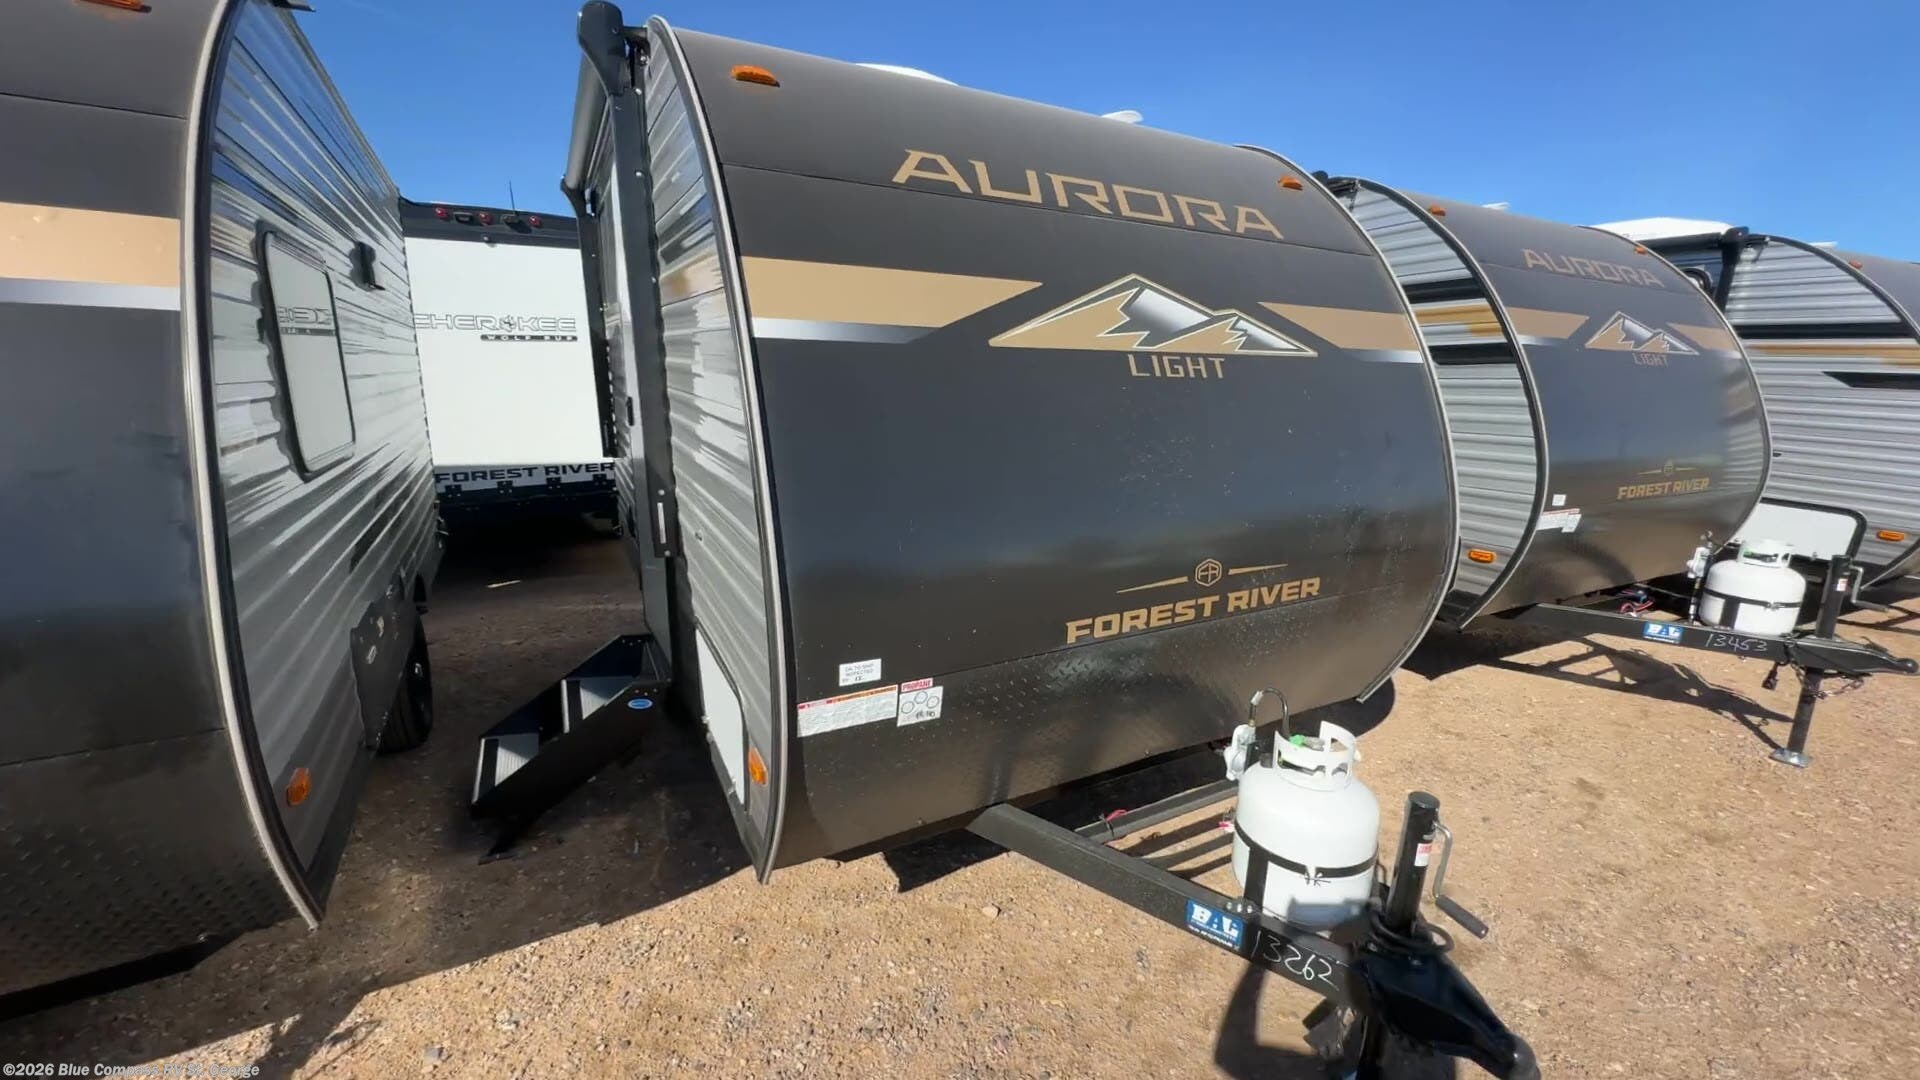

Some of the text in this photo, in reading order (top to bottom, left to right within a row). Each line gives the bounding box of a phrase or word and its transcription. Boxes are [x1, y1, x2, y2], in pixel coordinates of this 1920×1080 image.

[892, 149, 1284, 240] AURORA
[1522, 249, 1665, 288] AURORA
[1127, 354, 1225, 379] LIGHT
[1632, 353, 1669, 366] LIGHT
[434, 462, 616, 484] FOREST RIVER
[1616, 478, 1710, 500] FOREST RIVER
[1065, 576, 1321, 645] FOREST RIVER
[1705, 632, 1768, 652] 13453
[1251, 930, 1340, 992] 13262
